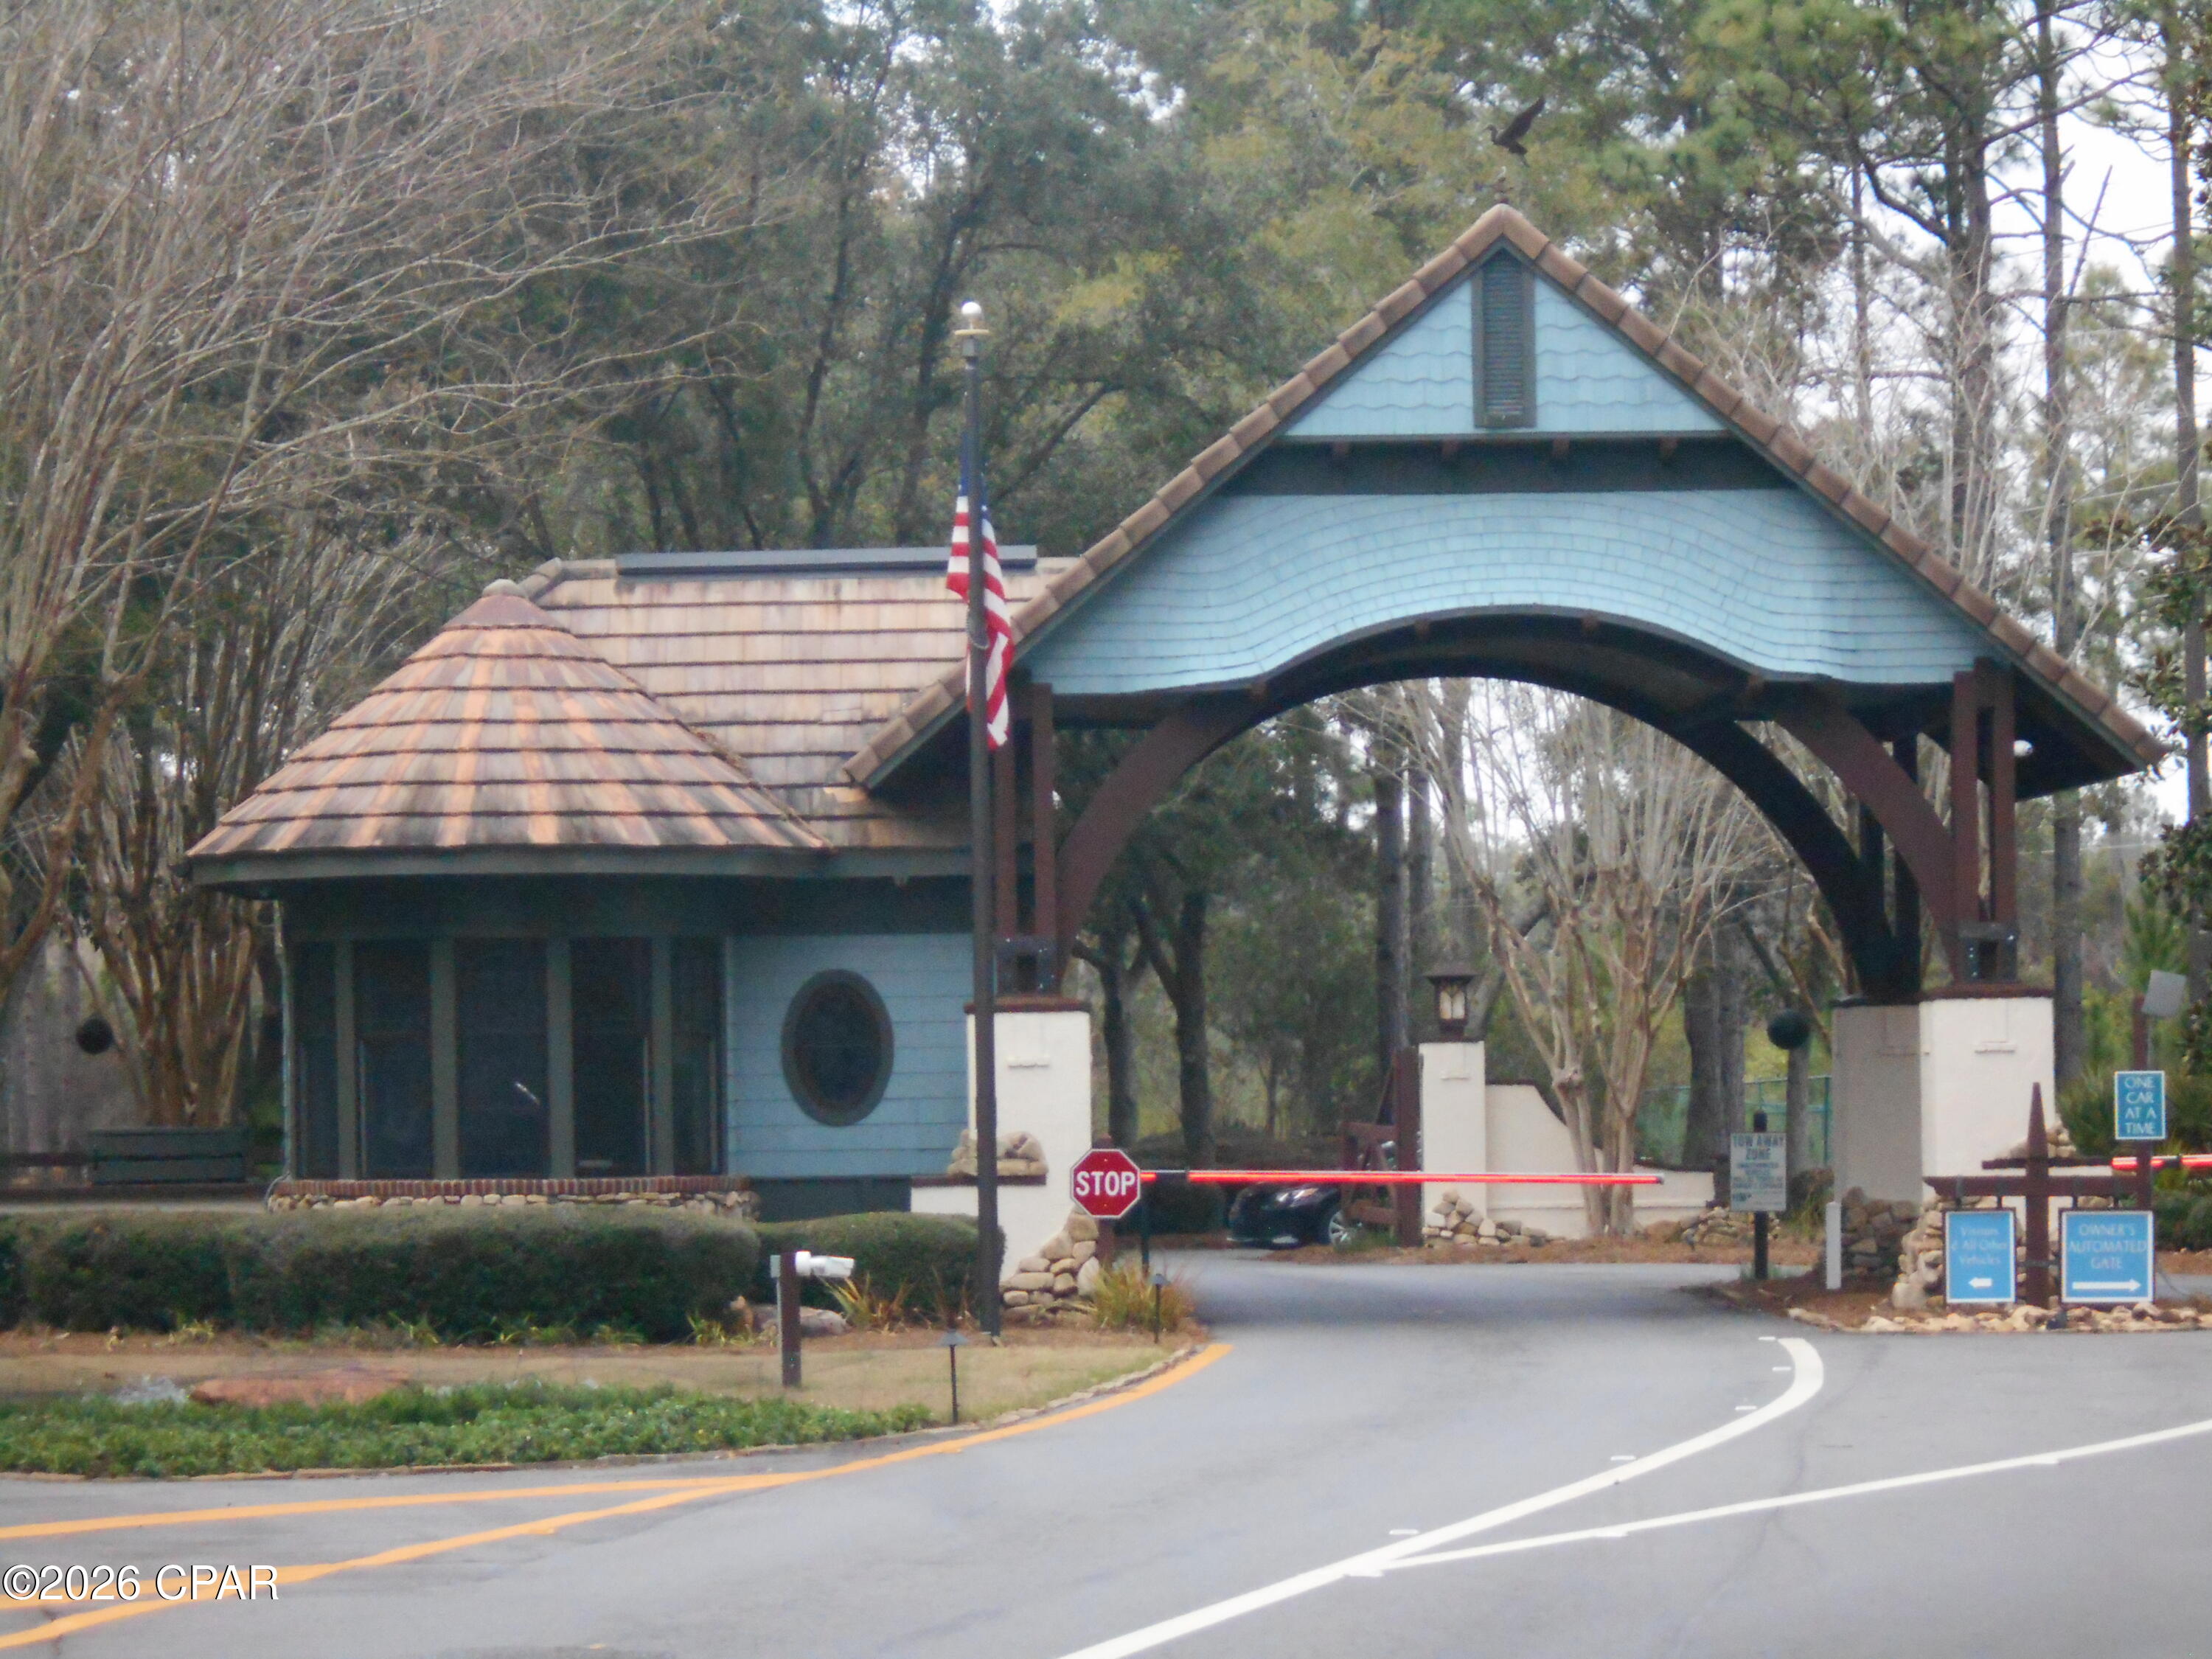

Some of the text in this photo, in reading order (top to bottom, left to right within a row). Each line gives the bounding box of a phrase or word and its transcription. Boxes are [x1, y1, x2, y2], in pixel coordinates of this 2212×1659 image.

[2124, 1076, 2154, 1089] ONE
[2126, 1091, 2154, 1104] CAR
[2125, 1106, 2157, 1119] AT A
[2125, 1121, 2154, 1135] TIME
[1075, 1170, 1136, 1197] STOP
[2079, 1222, 2135, 1236] OWNER'S
[2068, 1239, 2147, 1253] AUTOMATED
[2090, 1255, 2123, 1269] GATE
